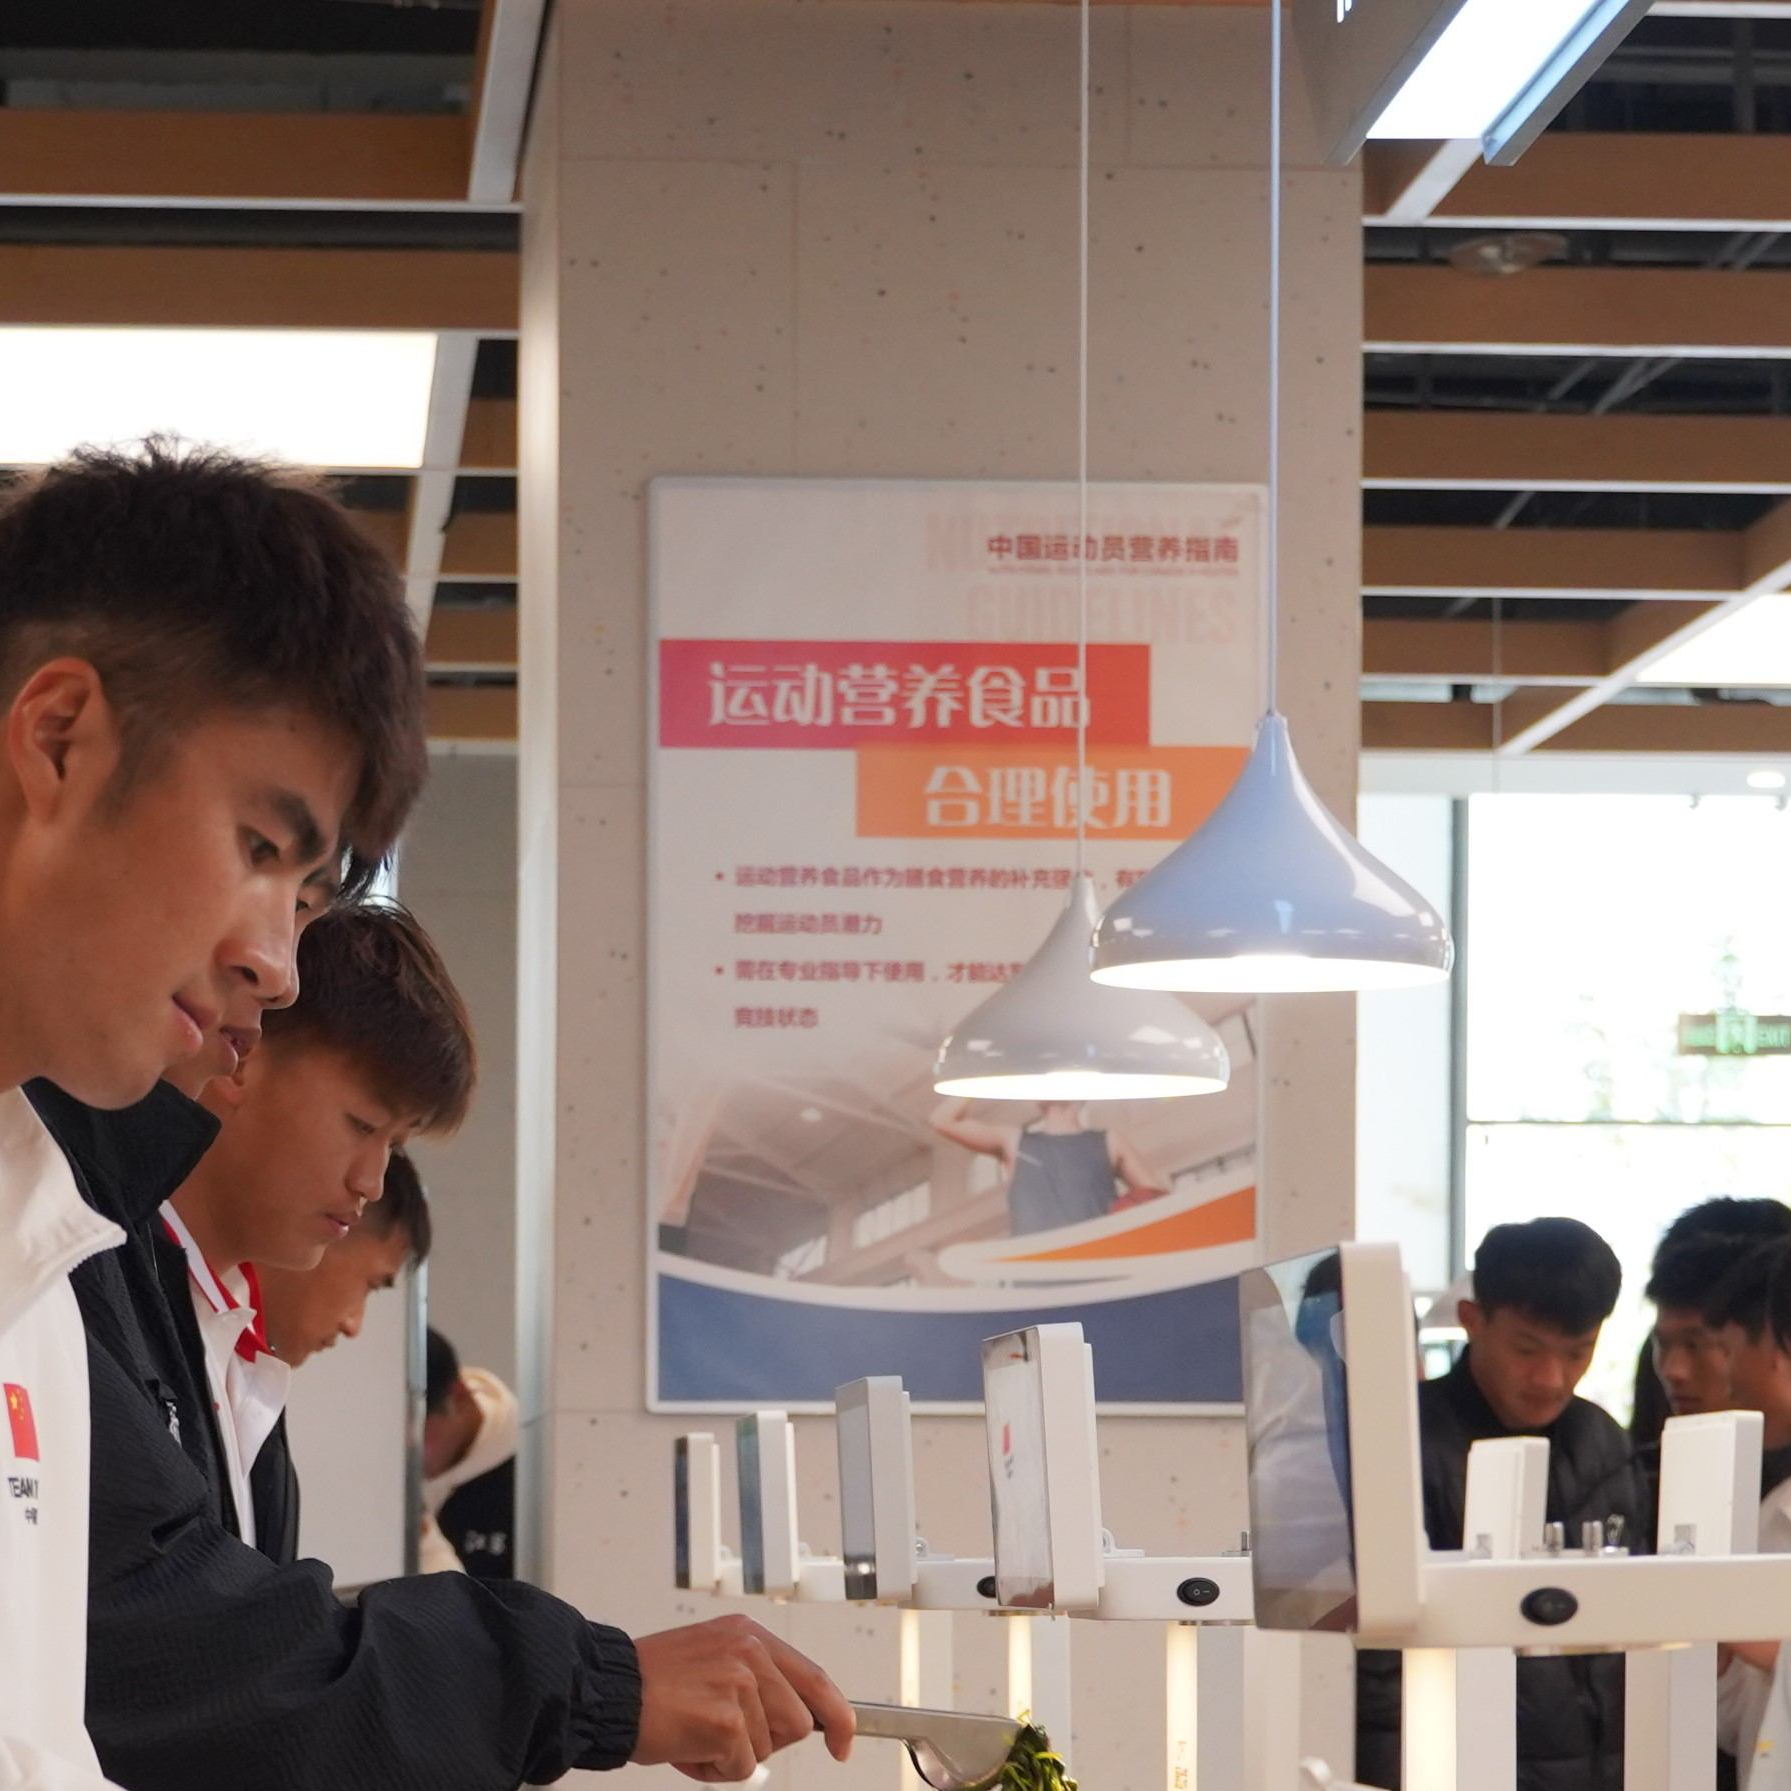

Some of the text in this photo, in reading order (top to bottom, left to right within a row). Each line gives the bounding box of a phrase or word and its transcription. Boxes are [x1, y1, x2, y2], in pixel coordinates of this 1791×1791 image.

[987, 534, 1240, 562] 中国运动员营养指南
[709, 662, 1090, 729] 运动营养食品
[923, 765, 1171, 830] 合理使用
